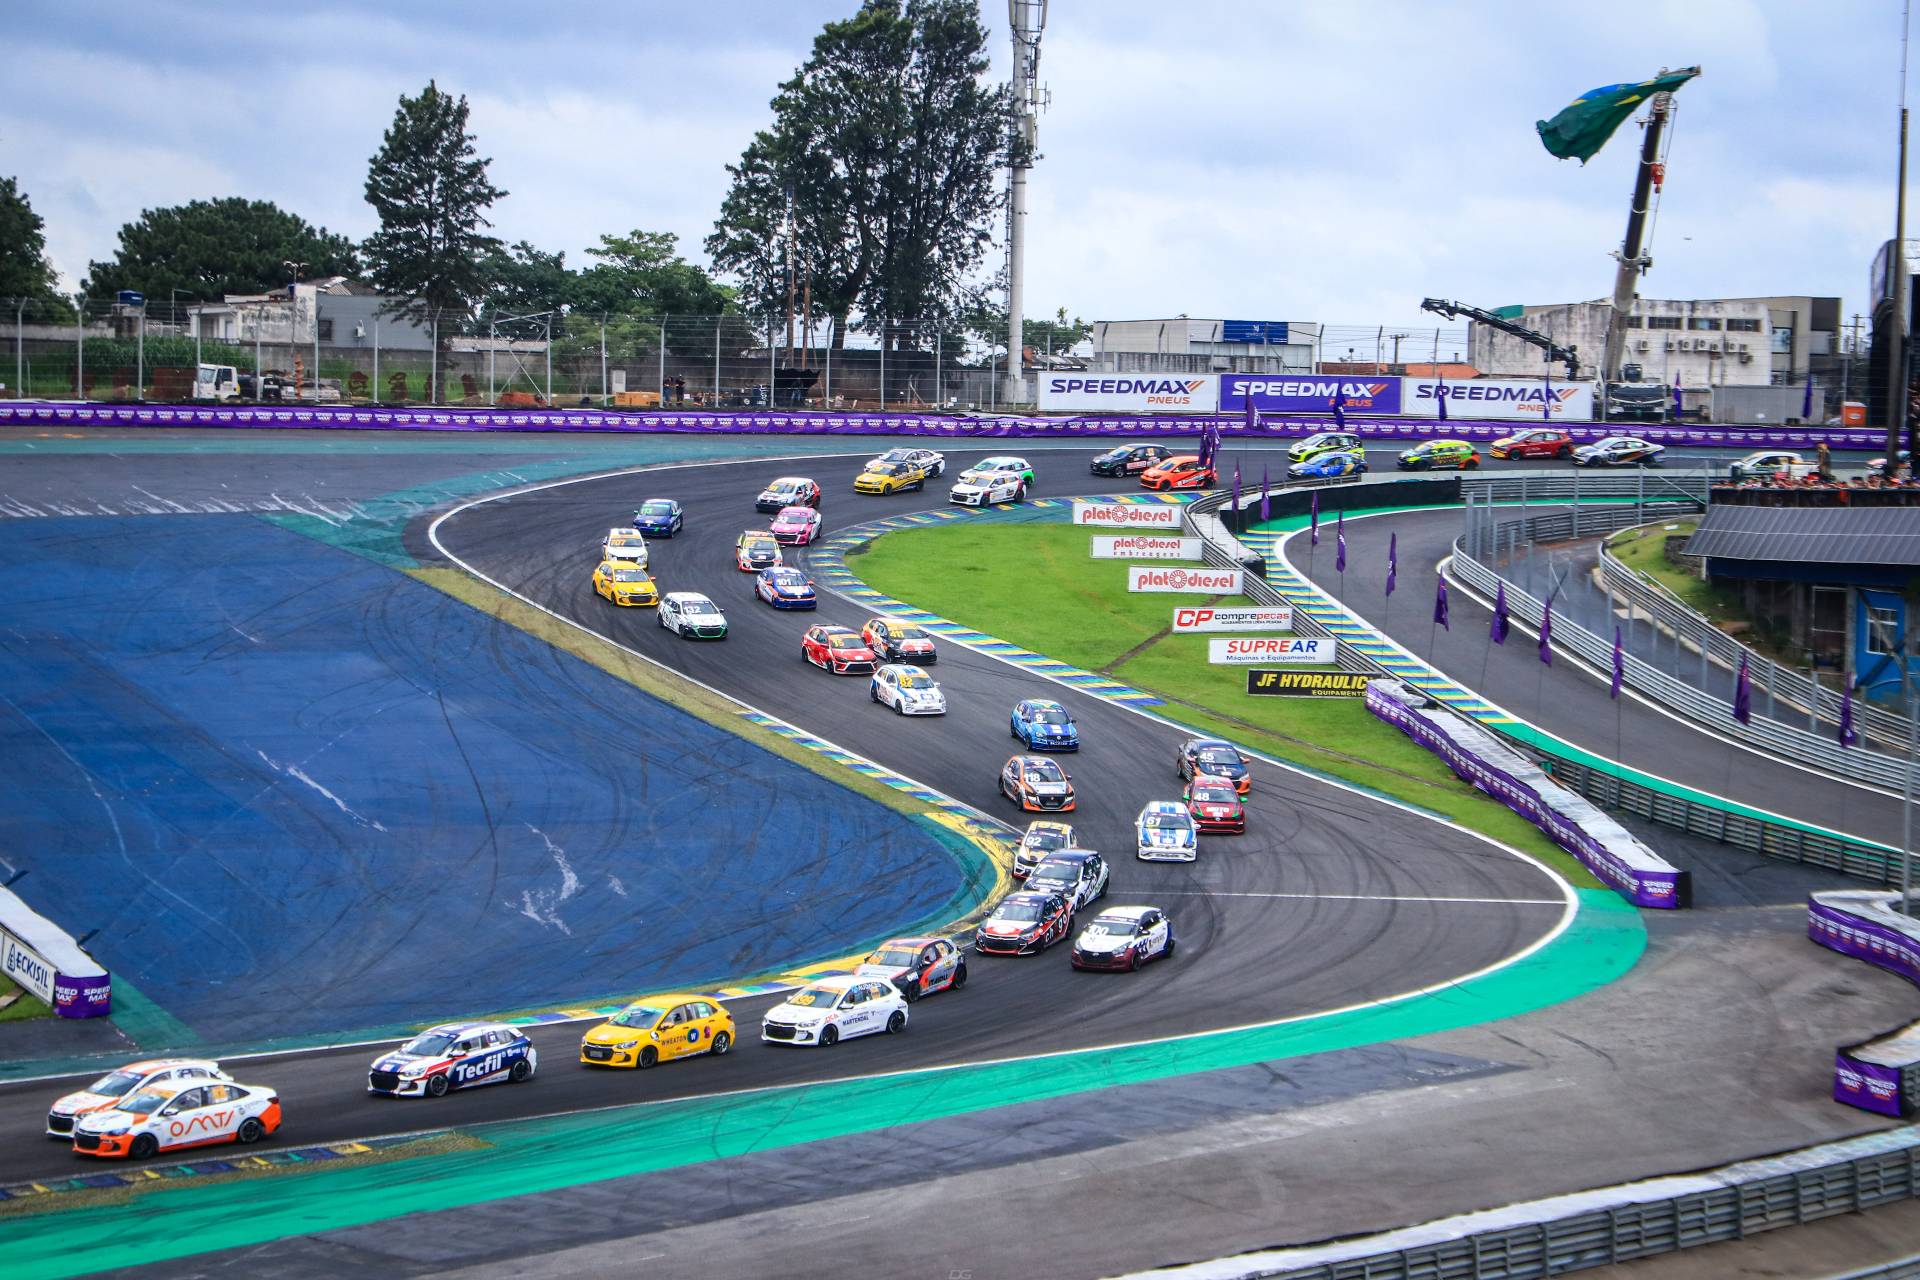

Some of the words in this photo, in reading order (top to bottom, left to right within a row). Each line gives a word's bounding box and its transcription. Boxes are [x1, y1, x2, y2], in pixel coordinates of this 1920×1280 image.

[1050, 379, 1204, 395] SPEEDMAX
[1232, 381, 1388, 398] SPEEDMAX
[1416, 384, 1578, 402] SPEEDMAX
[1147, 396, 1190, 405] PNEUS
[1328, 398, 1372, 407] PEUS
[776, 578, 791, 586] 101
[1176, 610, 1214, 627] CP
[1227, 640, 1318, 653] SUPREAR
[1256, 673, 1277, 687] JF
[1280, 674, 1372, 690] HYDRAULIC
[1036, 713, 1043, 722] 9
[1200, 752, 1214, 760] 45
[1194, 792, 1210, 801] 48
[1146, 817, 1161, 826] 61
[1026, 837, 1042, 847] 92
[16, 951, 48, 988] ECKISIL
[83, 986, 110, 996] SPEED
[456, 1052, 502, 1082] Tecfil
